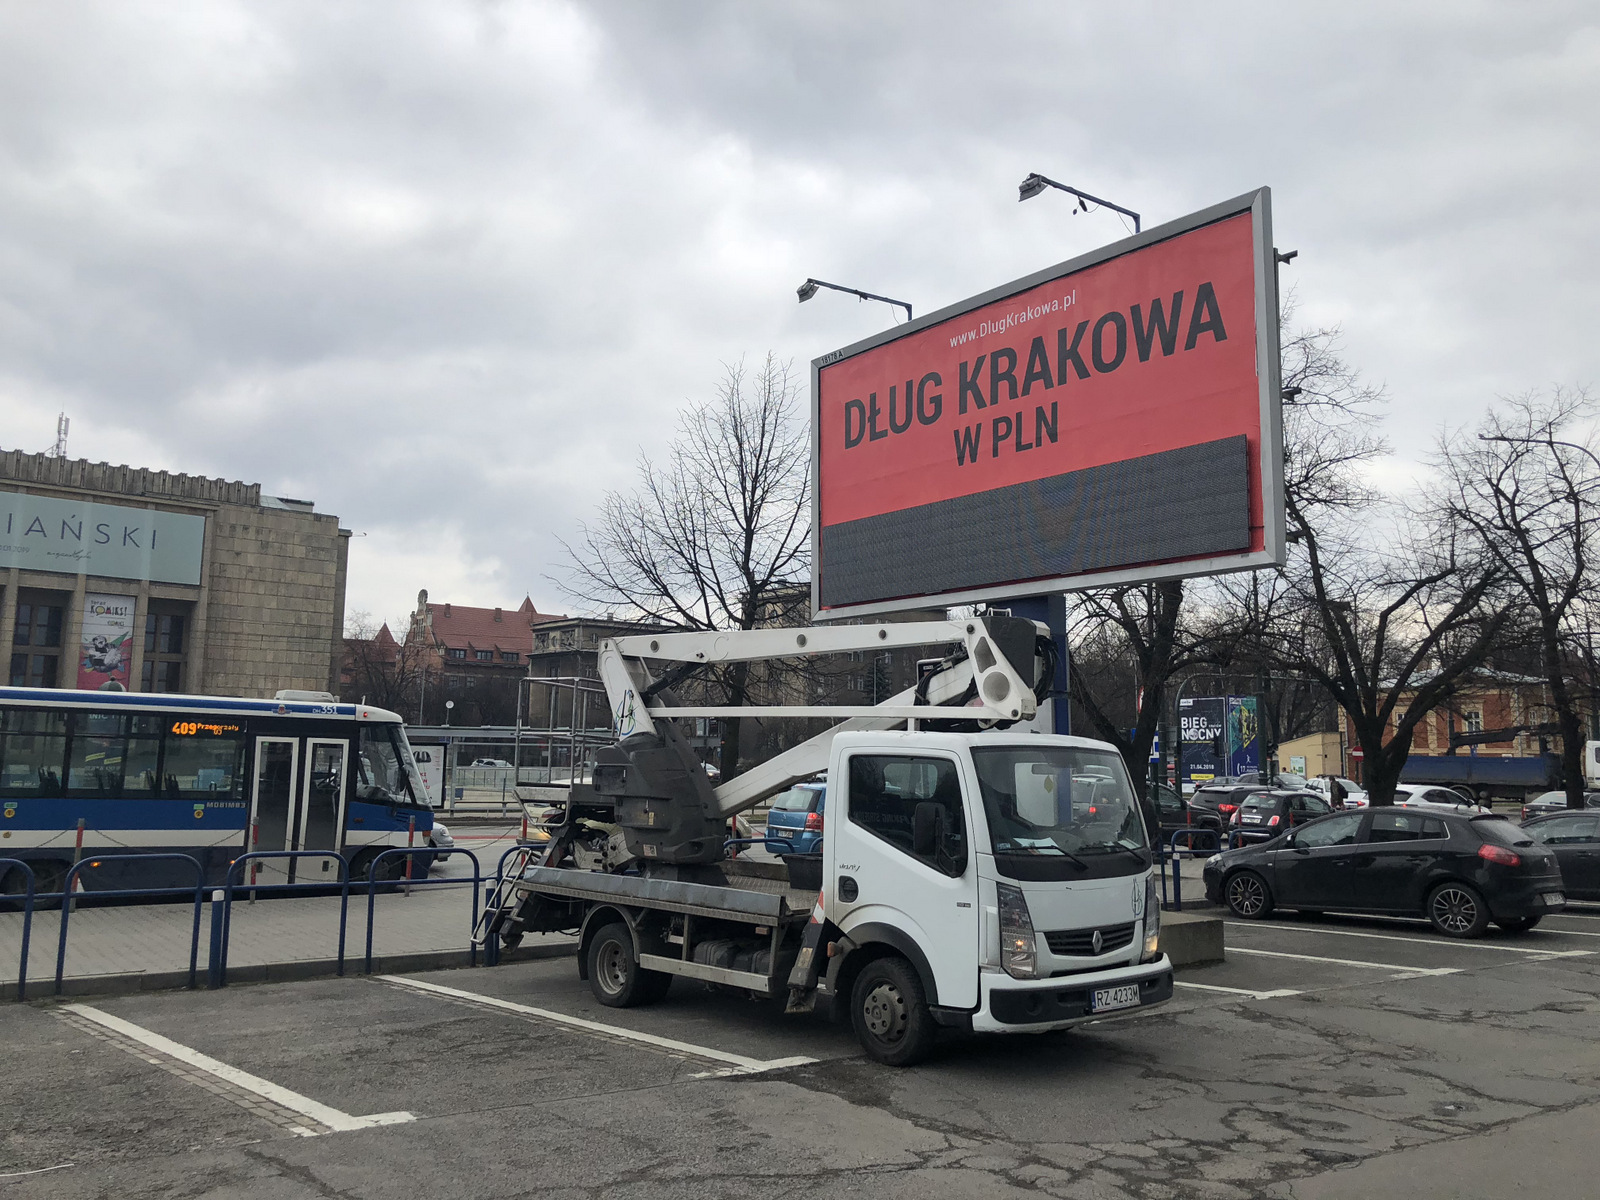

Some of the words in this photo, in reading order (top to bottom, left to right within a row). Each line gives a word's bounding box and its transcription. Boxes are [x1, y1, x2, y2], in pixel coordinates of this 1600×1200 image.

[950, 290, 1076, 347] www.DlugKrakowa.pl
[821, 352, 838, 364] 18178
[844, 371, 943, 450] DŁUG
[958, 281, 1228, 416] KRAKOWA
[953, 422, 982, 467] W
[992, 401, 1058, 458] PLN
[7, 513, 157, 550] IAŃSKI
[172, 721, 197, 735] 409
[1181, 717, 1208, 729] BIEG
[1181, 728, 1221, 740] NOCNY
[1096, 990, 1111, 1007] RZ
[1113, 985, 1139, 1004] 4233M
